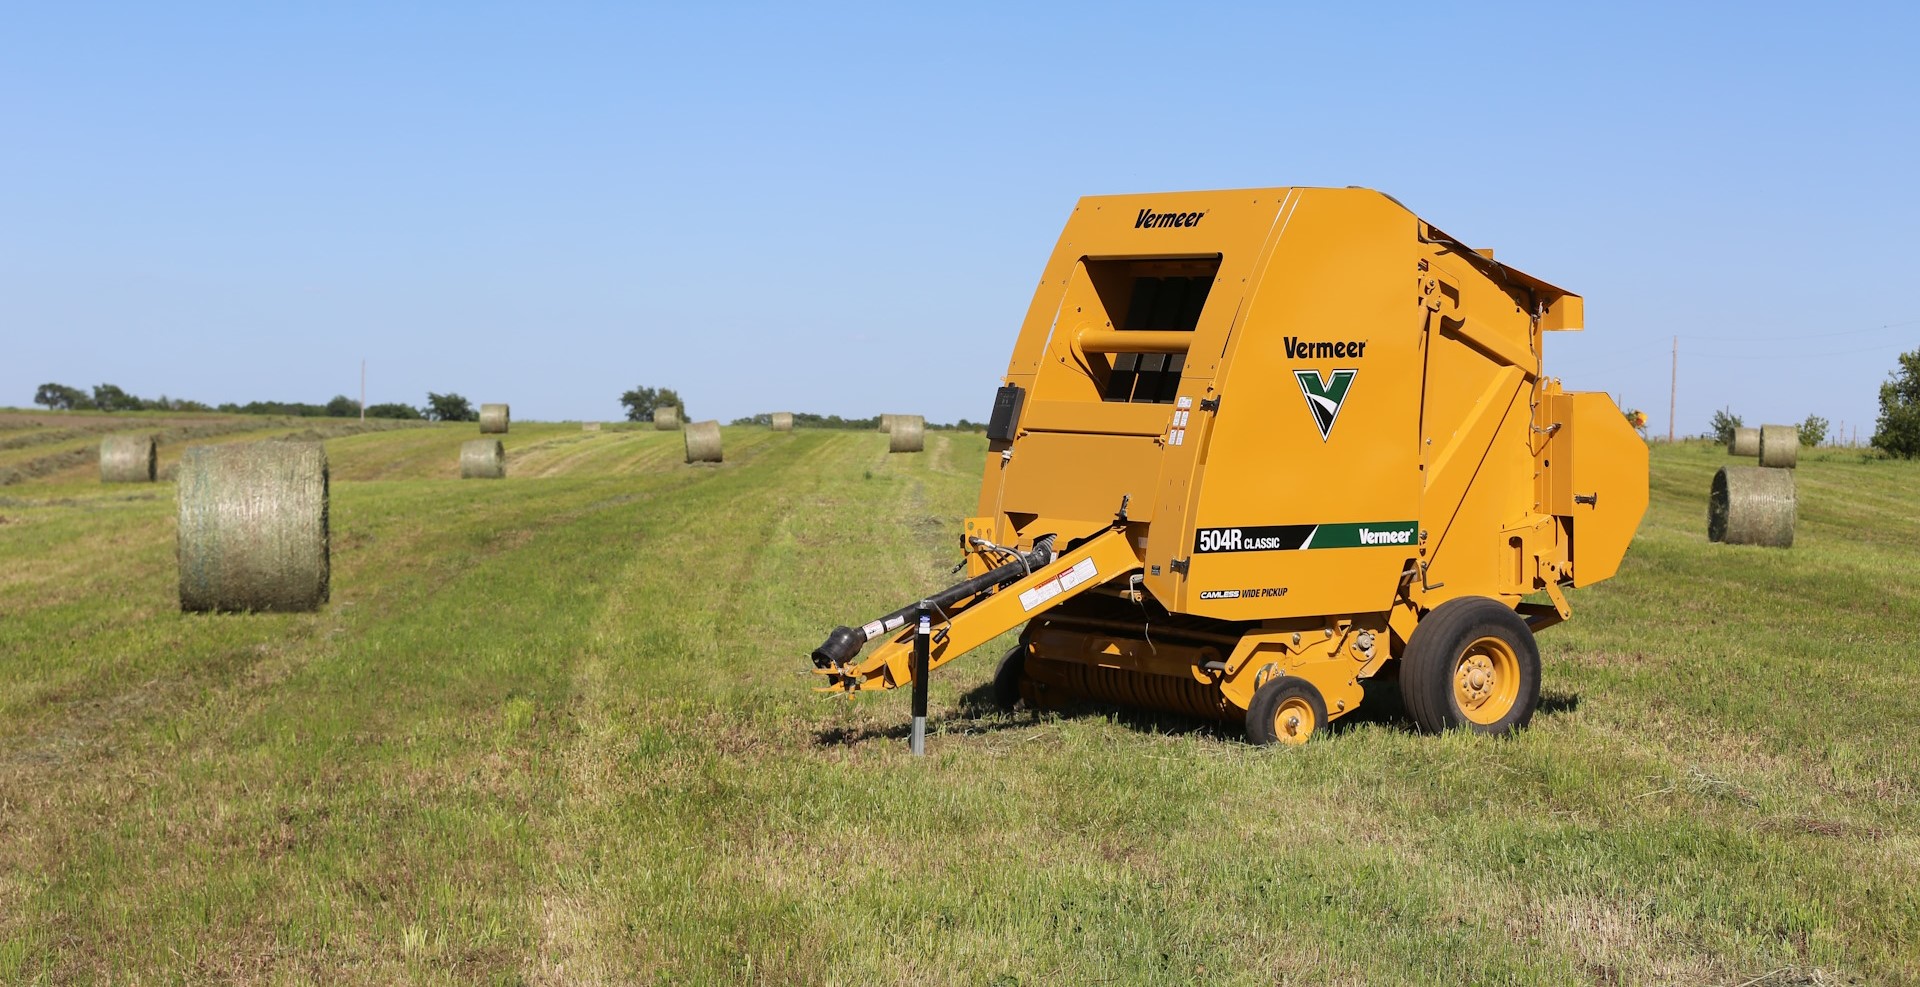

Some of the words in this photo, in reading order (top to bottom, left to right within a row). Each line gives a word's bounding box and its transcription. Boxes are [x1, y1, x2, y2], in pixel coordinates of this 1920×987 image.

[1134, 208, 1205, 228] Vermeer
[1283, 336, 1365, 359] Vermeer
[1200, 529, 1242, 551] 504R
[1244, 537, 1280, 549] CLASSIC
[1359, 528, 1410, 544] Vermeer
[1200, 590, 1240, 599] CAMLESS
[1242, 589, 1260, 598] WIDE
[1261, 587, 1288, 597] PICKUP
